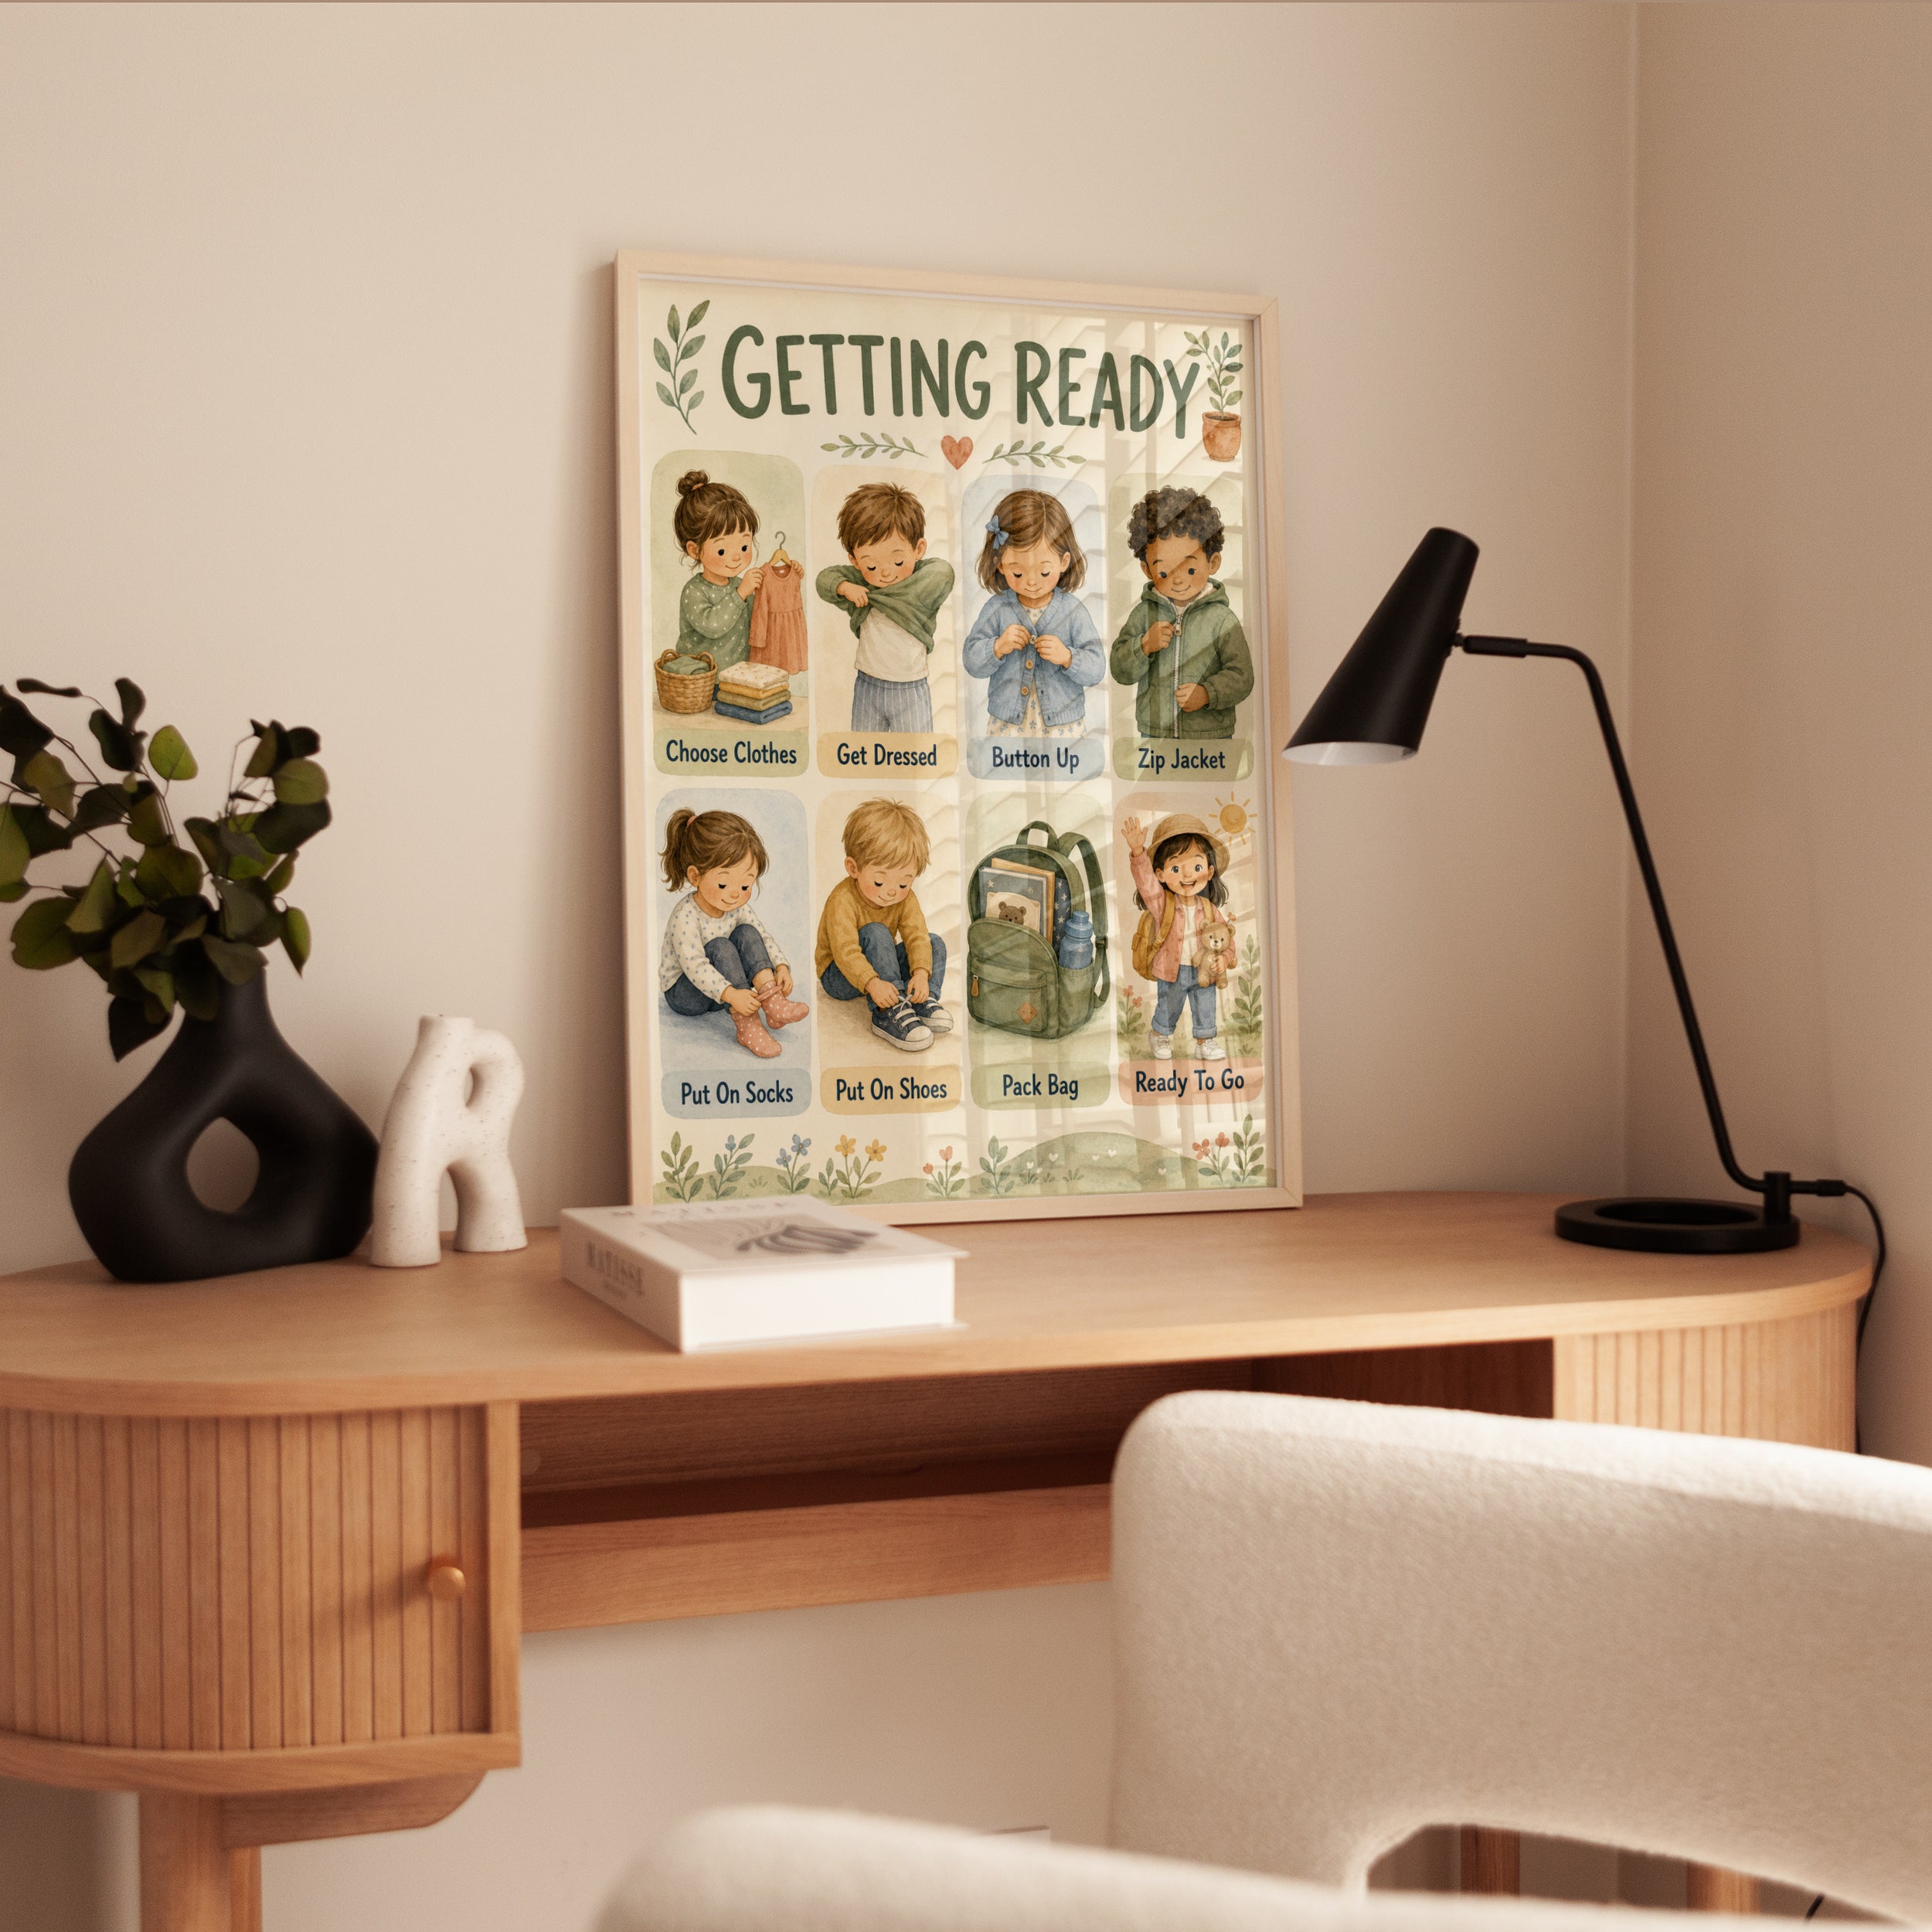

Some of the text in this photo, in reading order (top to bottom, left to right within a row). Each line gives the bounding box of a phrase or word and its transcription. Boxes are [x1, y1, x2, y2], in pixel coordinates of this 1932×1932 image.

[722, 325, 1200, 439] GETTING READY
[666, 740, 797, 764] Choose Clothes
[837, 743, 937, 766] Get Dressed
[992, 747, 1080, 774] Button Up
[1138, 747, 1226, 774] Zip Jacket
[682, 1080, 794, 1105] Put On Socks
[836, 1077, 947, 1100] Put On Shoes
[1003, 1073, 1079, 1100] Pack Bag
[1136, 1068, 1245, 1097] Ready To Go
